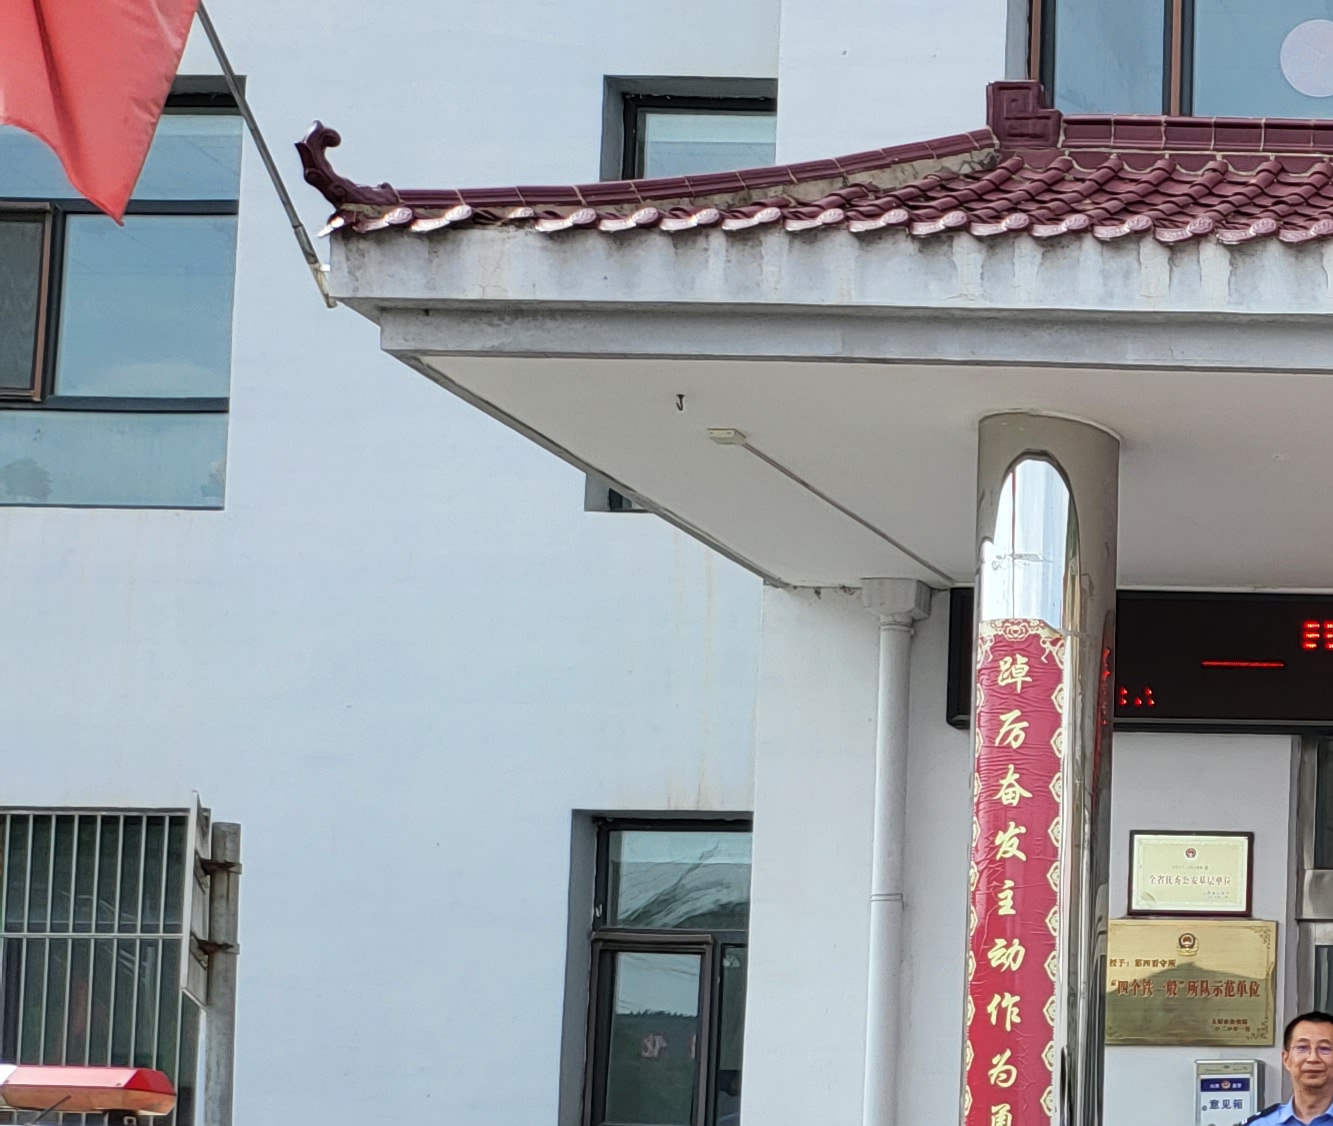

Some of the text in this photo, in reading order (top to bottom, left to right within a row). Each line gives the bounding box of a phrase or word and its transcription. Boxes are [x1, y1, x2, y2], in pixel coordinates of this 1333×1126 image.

[1148, 874, 1232, 887] 全省优秀公安基层单位
[1208, 1098, 1244, 1110] 意见箱
